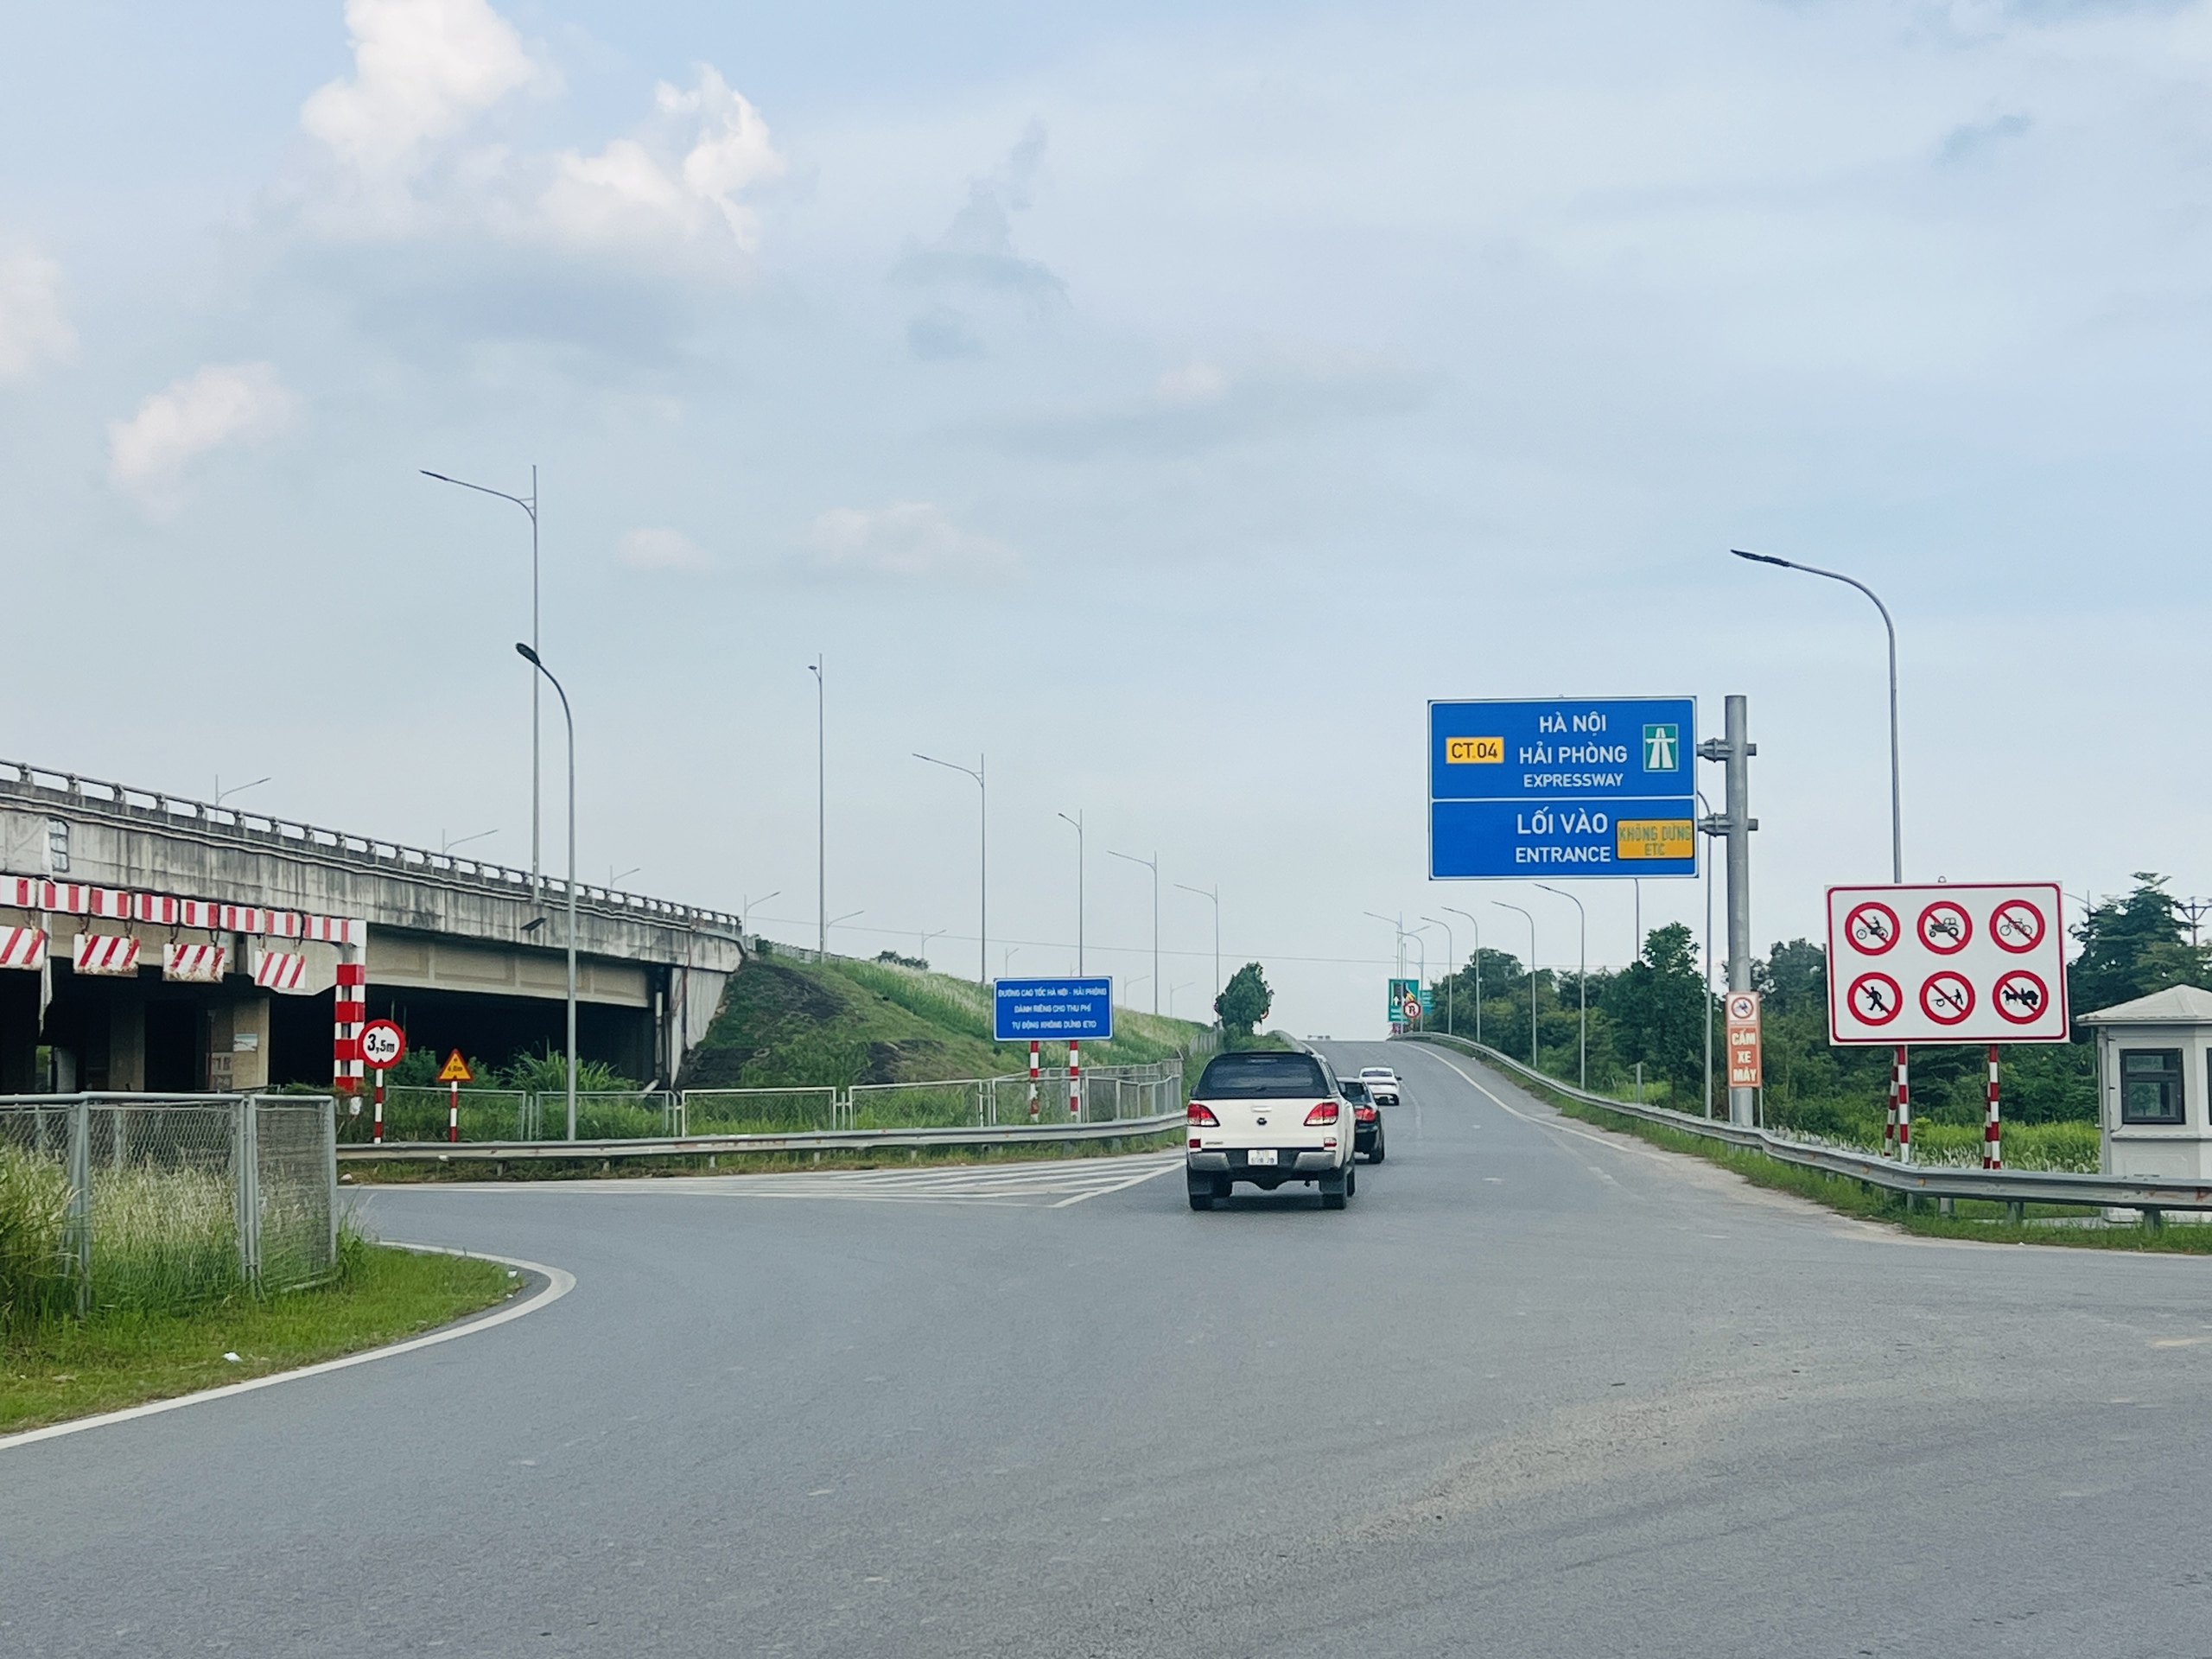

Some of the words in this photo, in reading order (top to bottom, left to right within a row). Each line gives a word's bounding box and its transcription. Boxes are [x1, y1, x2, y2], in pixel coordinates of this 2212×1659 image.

[1539, 711, 1567, 733] HÀ
[1573, 711, 1606, 736] NỘI
[1451, 741, 1498, 759] CT.04
[1519, 741, 1552, 765] HẢI
[1558, 741, 1627, 764] PHÒNG
[1523, 772, 1624, 788] EXPRESSWAY
[1516, 806, 1554, 835] LỐI
[1560, 807, 1608, 834] VÀO
[1618, 823, 1658, 842] KHÔNG
[1515, 846, 1611, 863] ENTRANCE
[1644, 842, 1665, 856] ETC
[1034, 986, 1046, 997] TỐC
[1047, 987, 1056, 996] HÀ
[1080, 1002, 1092, 1012] PHÍ
[367, 1033, 395, 1054] 3,5m
[1732, 1028, 1756, 1046] CẤM
[1737, 1050, 1751, 1064] XE
[1732, 1066, 1757, 1082] MÁY
